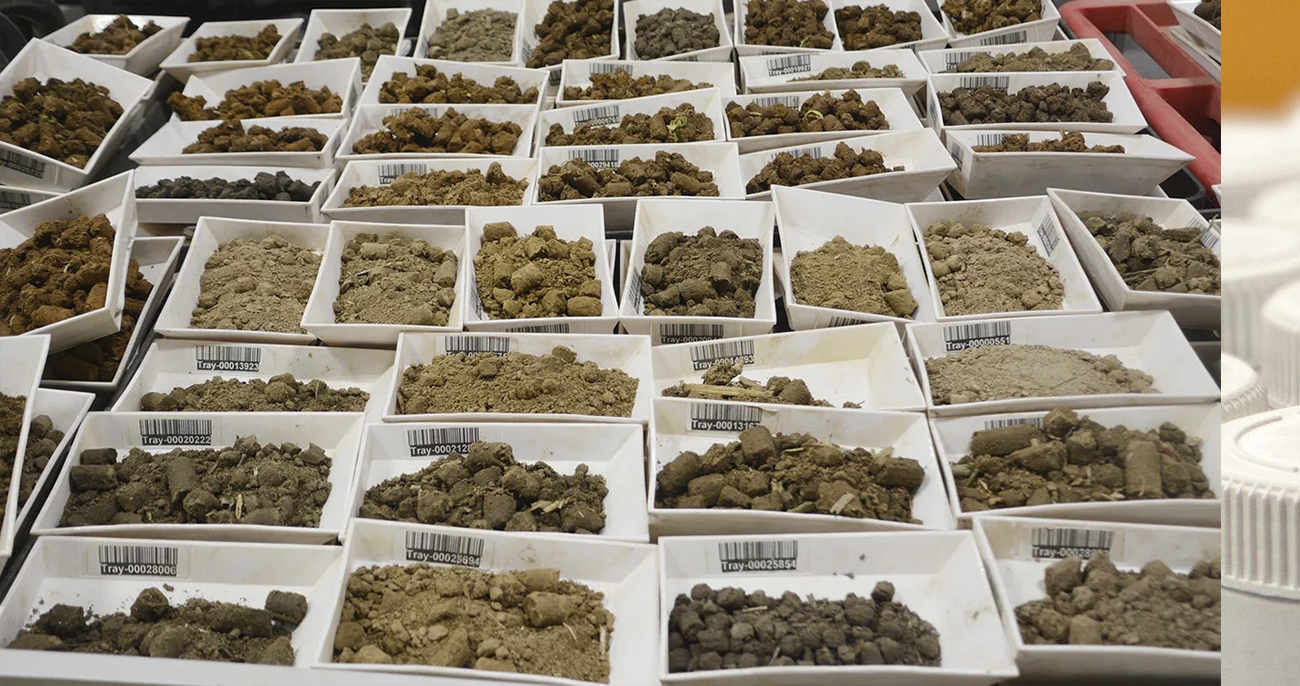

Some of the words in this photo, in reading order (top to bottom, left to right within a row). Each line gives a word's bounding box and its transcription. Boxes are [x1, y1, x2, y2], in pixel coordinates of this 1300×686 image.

[946, 336, 1010, 351] Tray-00000551
[198, 361, 260, 371] Tray-00013923
[693, 355, 754, 369] Tray-000193
[142, 435, 211, 446] Tray-00020222
[410, 443, 472, 456] Tray-000212
[406, 550, 480, 566] Tray-00025694
[1033, 547, 1109, 558] Tray-00028
[101, 563, 177, 575] Tray-00028006
[721, 560, 796, 572] Tray-00025854
